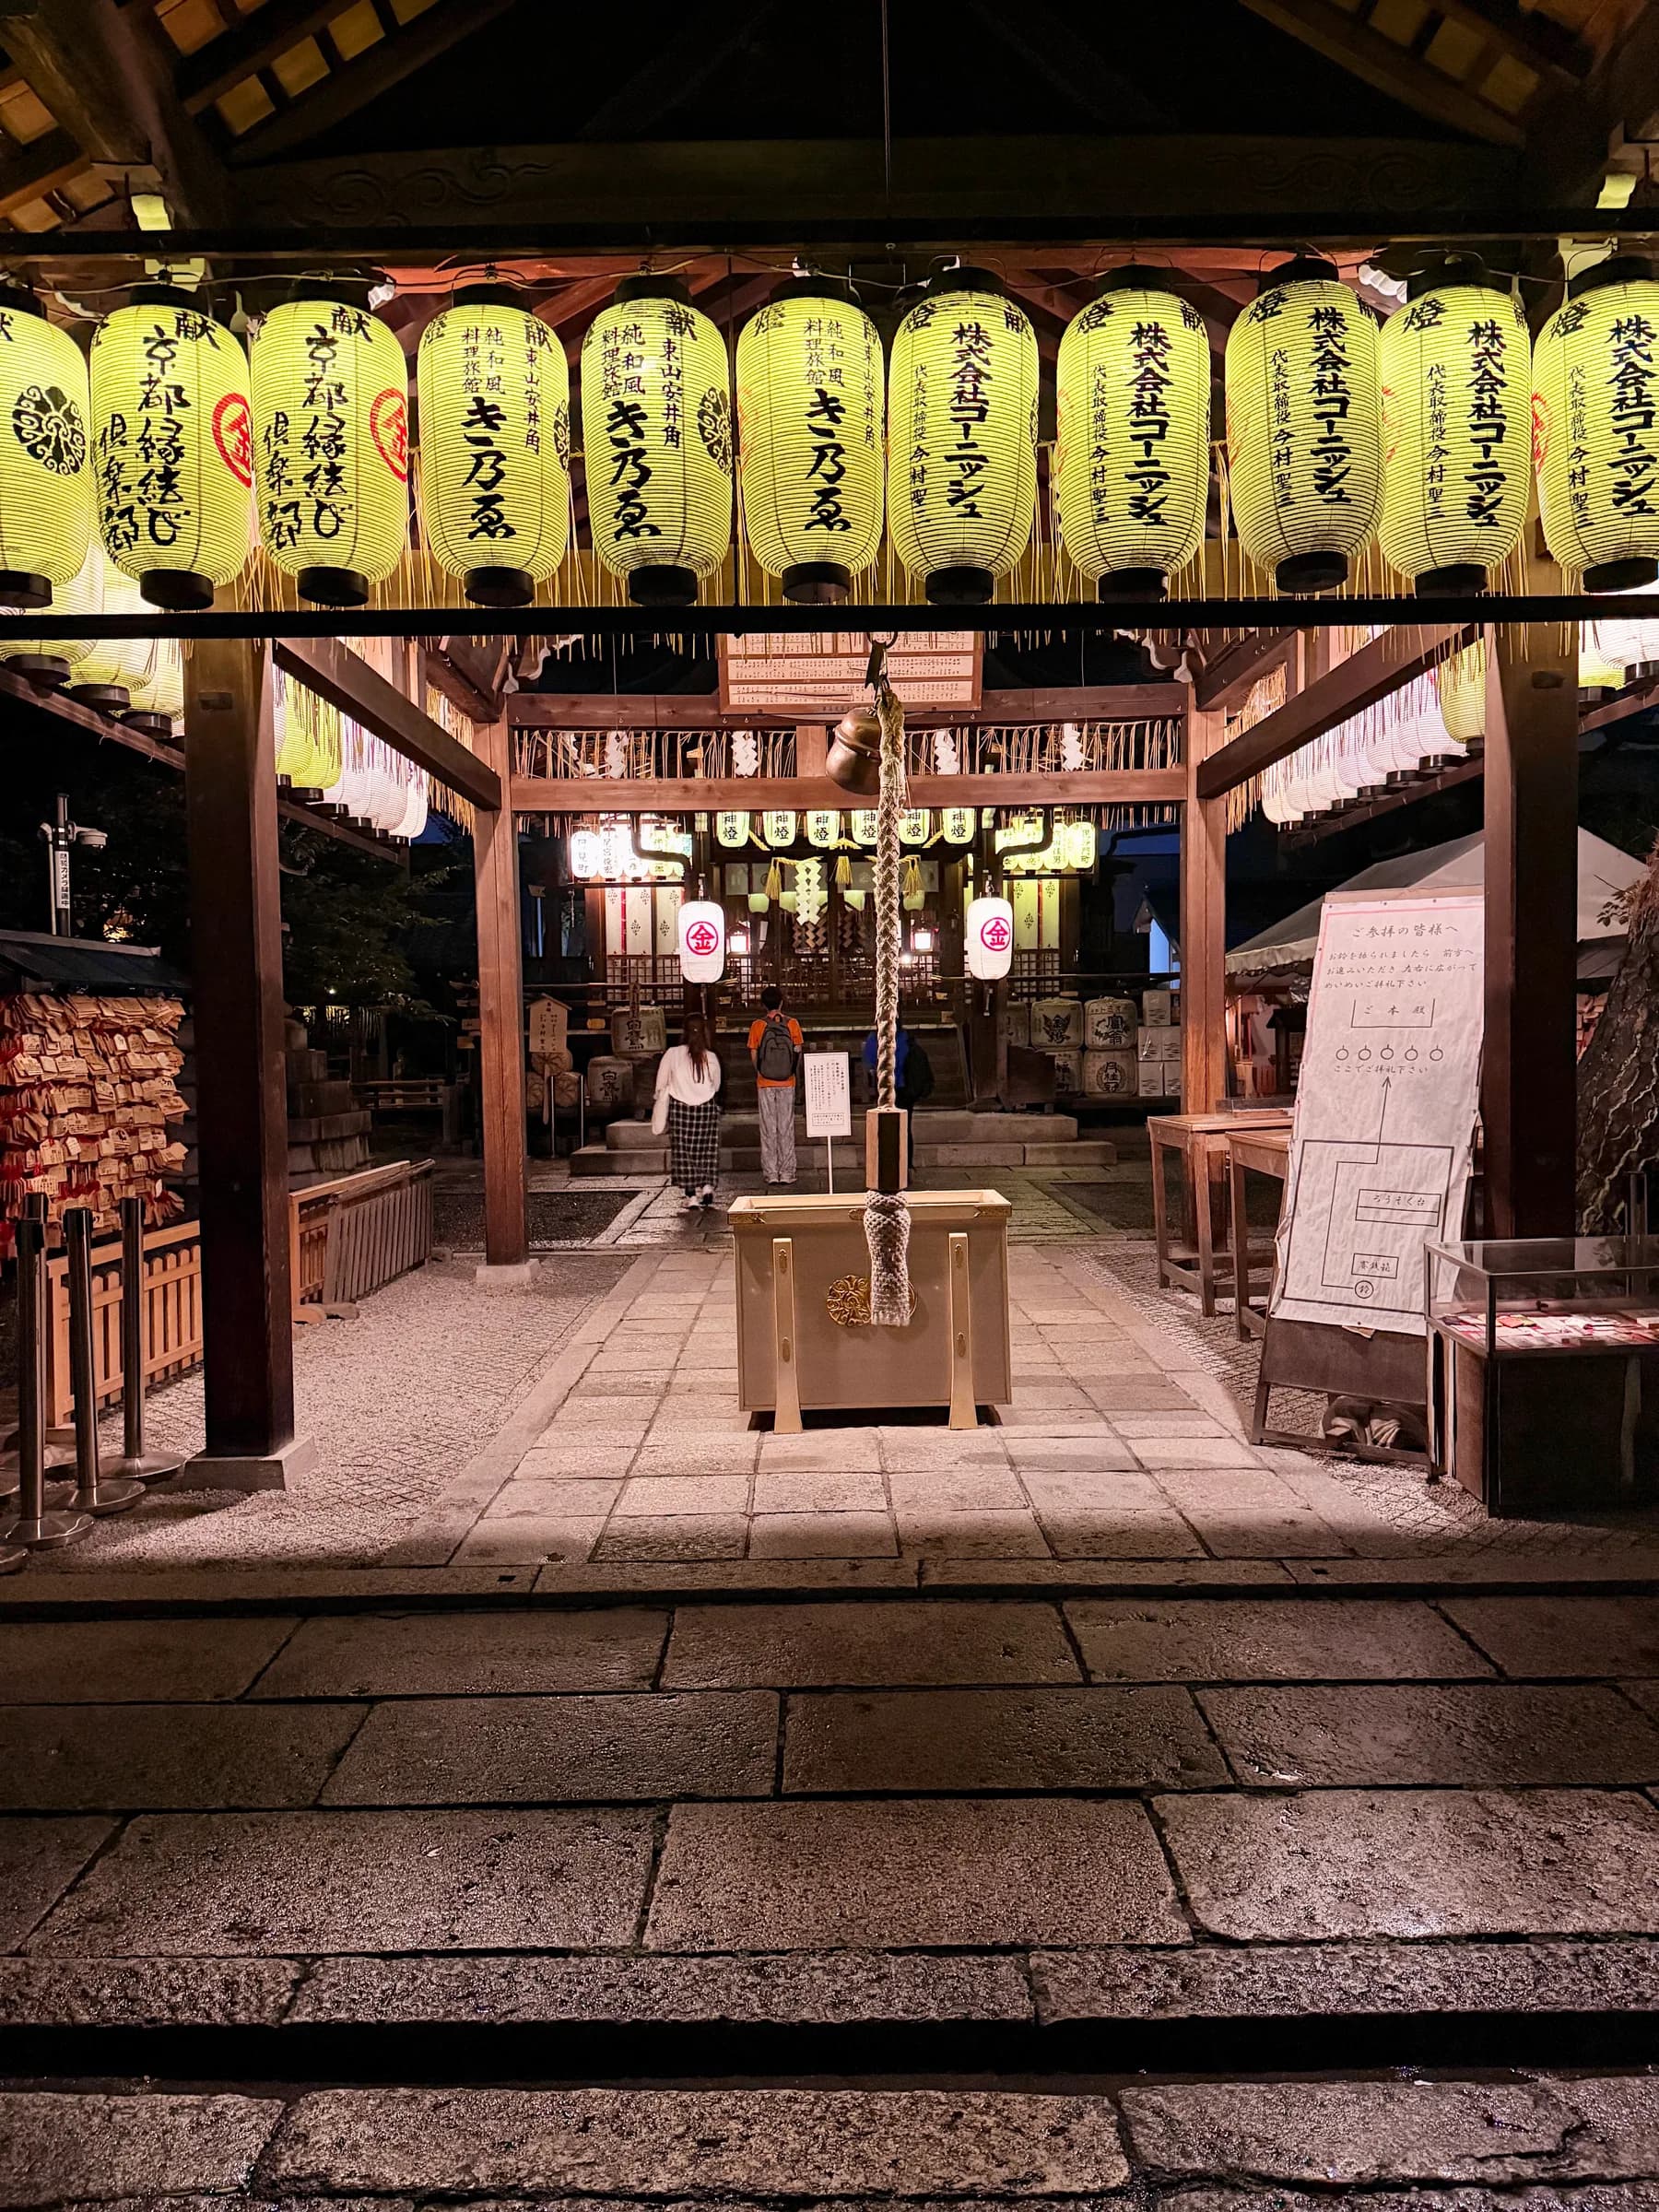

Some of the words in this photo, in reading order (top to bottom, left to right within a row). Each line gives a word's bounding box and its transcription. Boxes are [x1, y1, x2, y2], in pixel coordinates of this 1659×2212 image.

[804, 318, 827, 385] 料理旅館
[1402, 298, 1448, 334] 燈
[462, 326, 483, 394] 料理旅館
[484, 327, 506, 394] 純和風
[601, 326, 622, 400] 料理旅館
[621, 324, 646, 395] 純和風
[826, 319, 845, 388] 純和風
[523, 347, 540, 455] 東山安井角
[660, 338, 682, 449] 東山安井角
[945, 322, 994, 519] 株式会社コーニッシュ
[1124, 322, 1173, 526] 株式会社コーニッシュ
[1306, 306, 1352, 505] 株式会社コーニッシュ
[1464, 318, 1507, 528] 株式会社コーニッシュ
[1606, 313, 1658, 517] 株式会社コーニッシュ
[136, 324, 192, 546] 京都縁結び
[301, 324, 353, 538] 京都縁結び
[689, 924, 716, 951] 金
[985, 920, 1011, 947] 金
[1352, 923, 1459, 938] ご参拝の皆様へ
